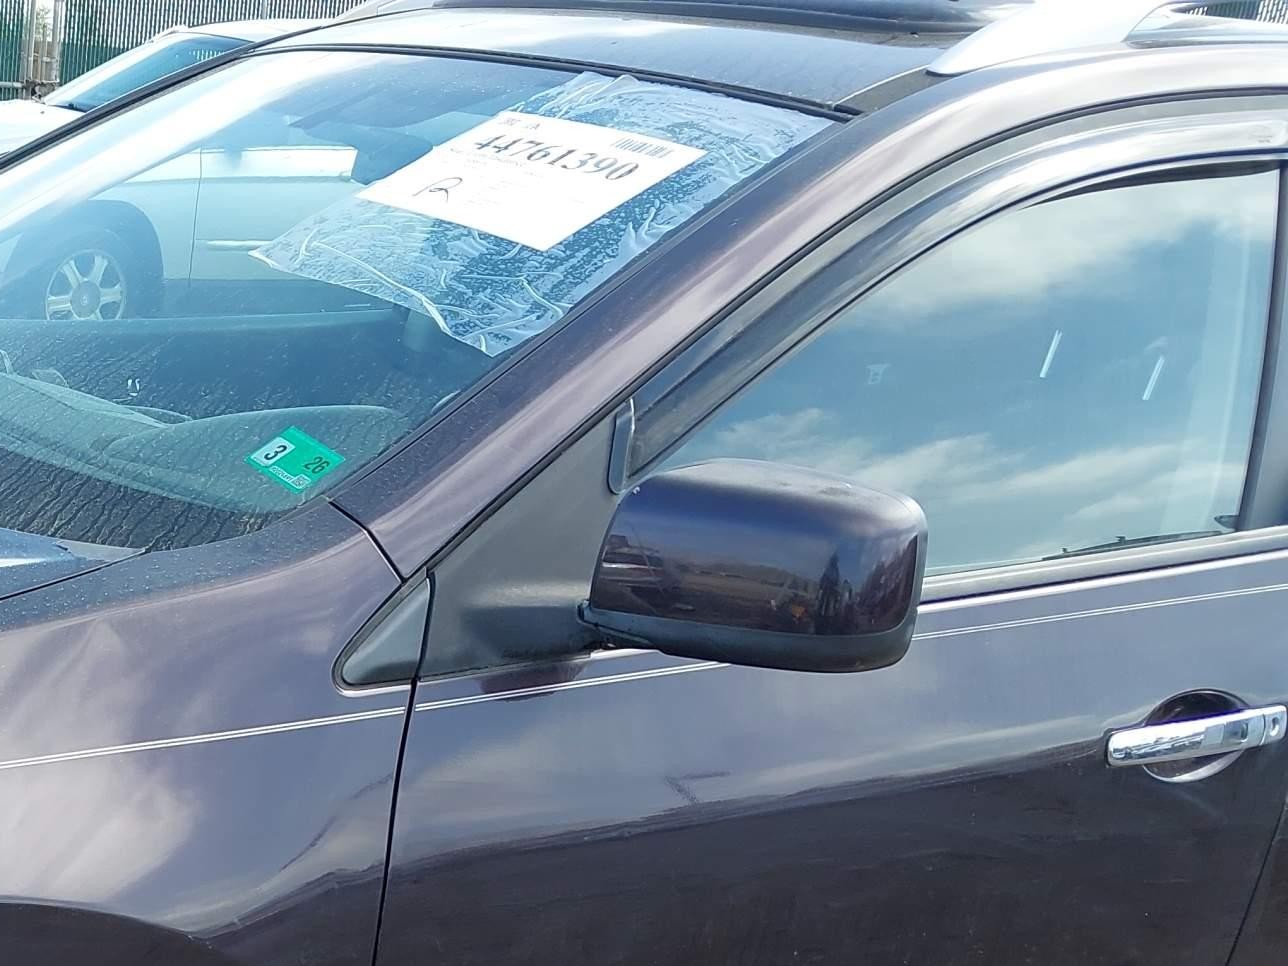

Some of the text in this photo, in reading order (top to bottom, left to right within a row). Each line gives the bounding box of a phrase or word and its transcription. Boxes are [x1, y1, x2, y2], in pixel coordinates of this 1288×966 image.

[475, 134, 640, 181] 44761390
[263, 444, 288, 461] 3
[304, 456, 330, 474] 26
